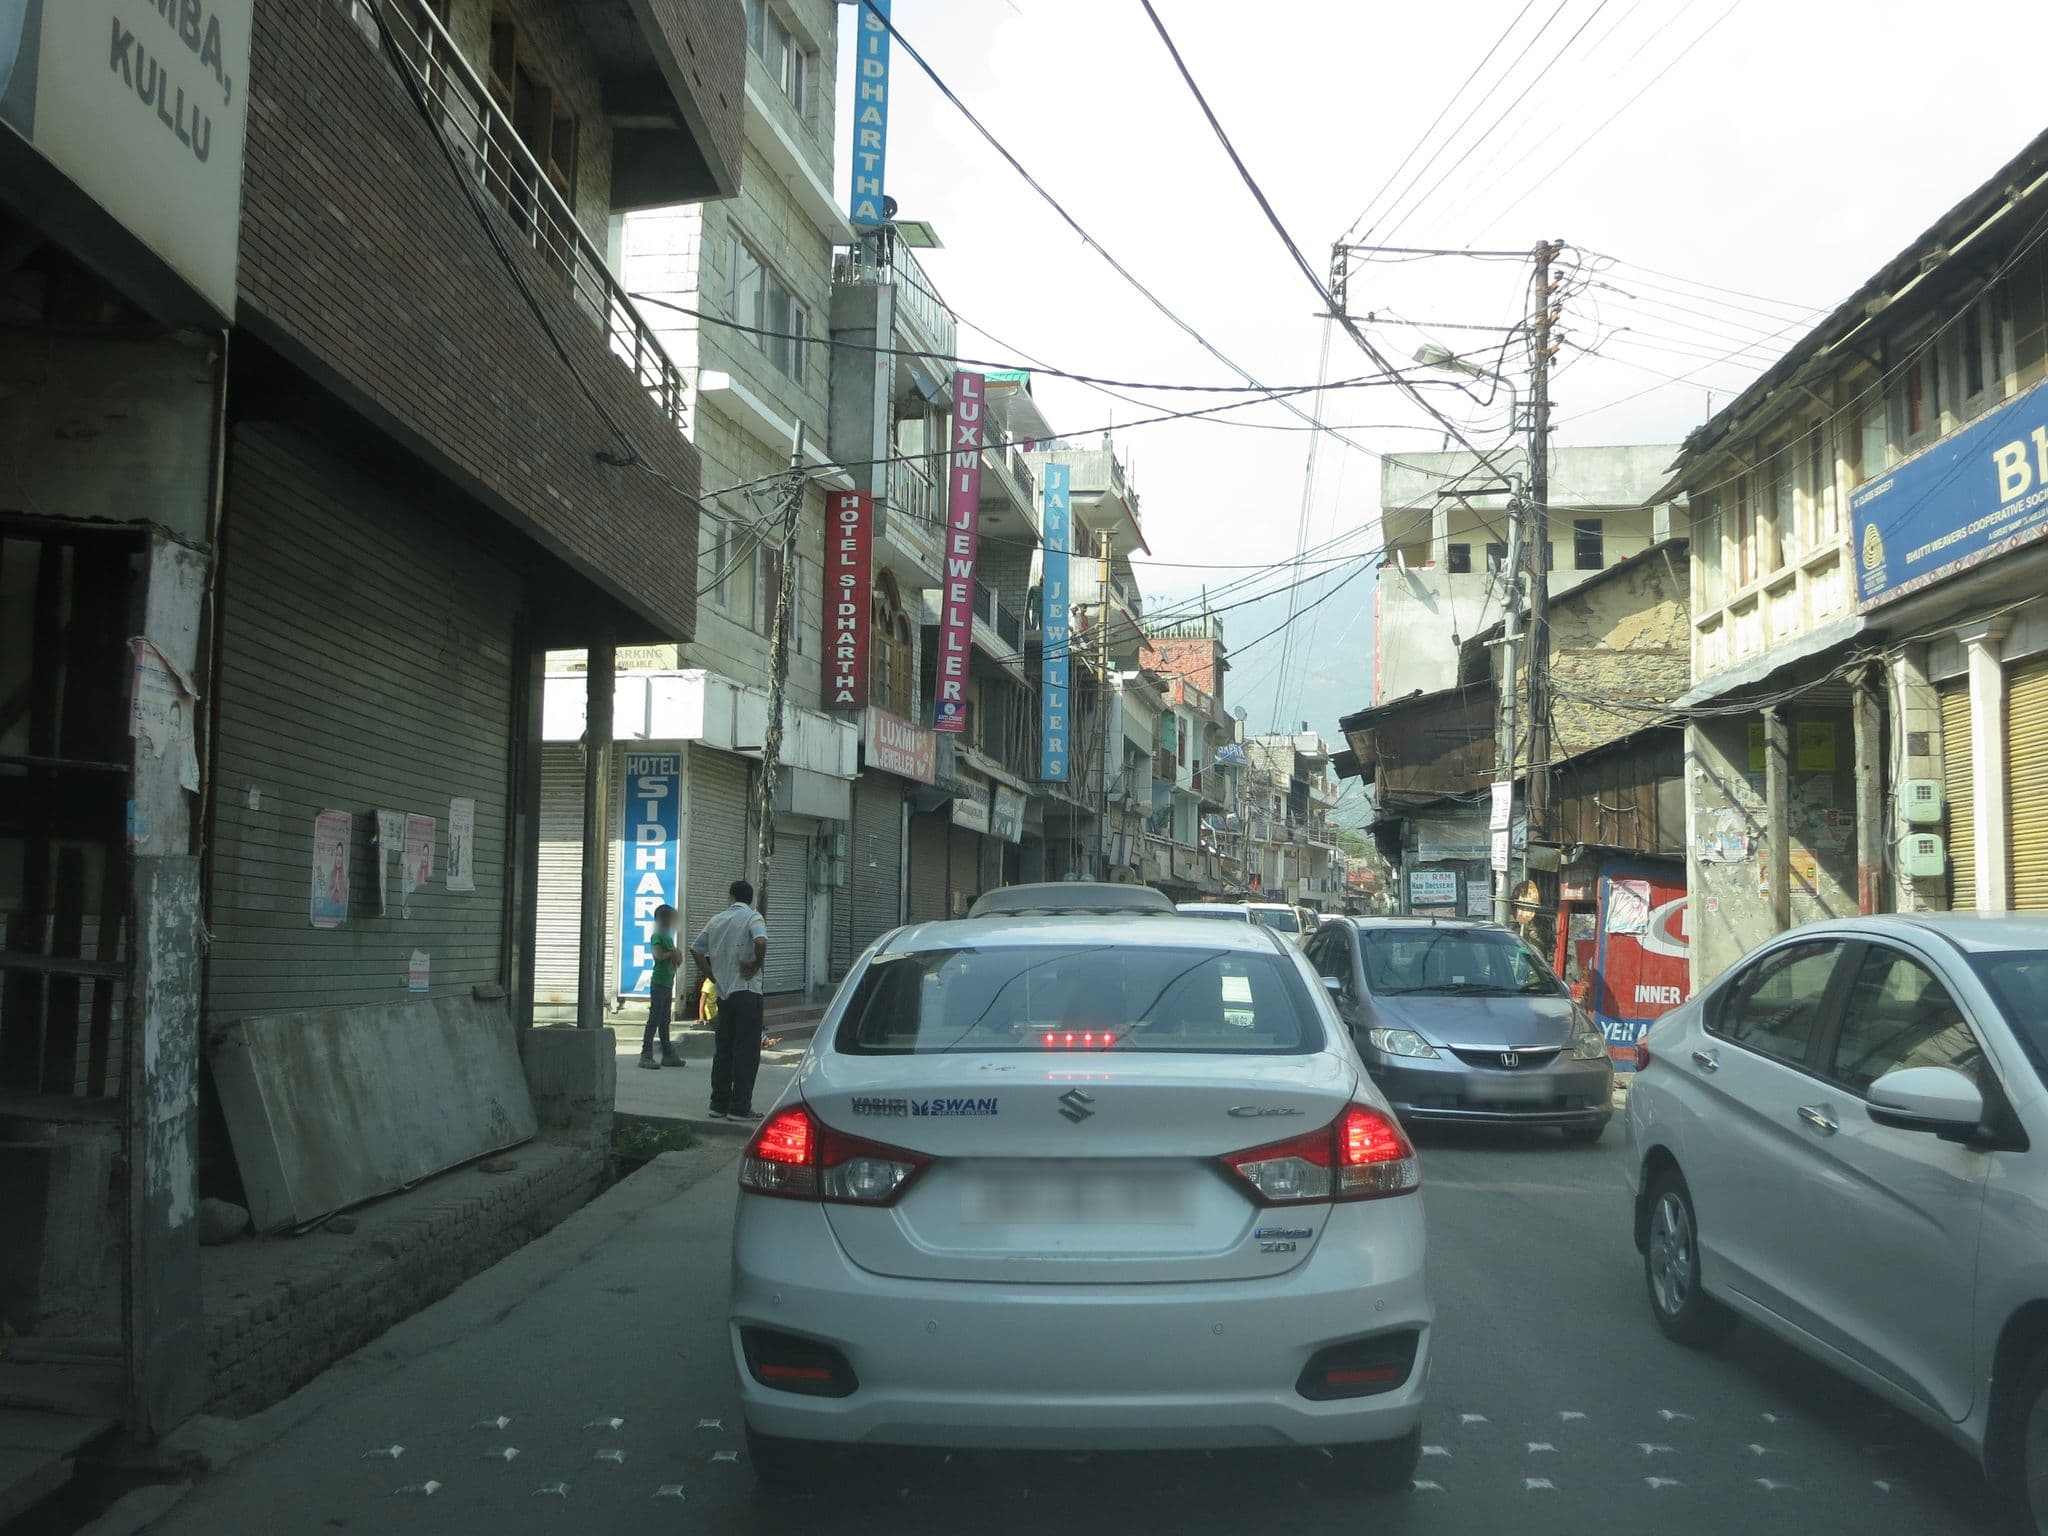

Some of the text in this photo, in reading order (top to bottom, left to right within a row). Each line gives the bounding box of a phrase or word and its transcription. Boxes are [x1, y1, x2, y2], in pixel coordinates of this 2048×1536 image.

[110, 15, 211, 163] KULLU
[856, 11, 885, 220] SIDHARTHA
[955, 378, 980, 494] LUXMI
[1967, 499, 2025, 535] COOPERATIVE
[834, 495, 859, 704] HOTEL SIDHARTHA
[943, 516, 974, 701] JEWELLER
[1046, 471, 1066, 777] JAIN JEWELLERS
[880, 717, 915, 753] LUXMI
[627, 757, 679, 776] HOTEL
[879, 746, 915, 777] JEWELLER
[1634, 984, 1681, 1005] INNER
[1600, 1020, 1634, 1041] YEH
[930, 1097, 999, 1112] SWANI
